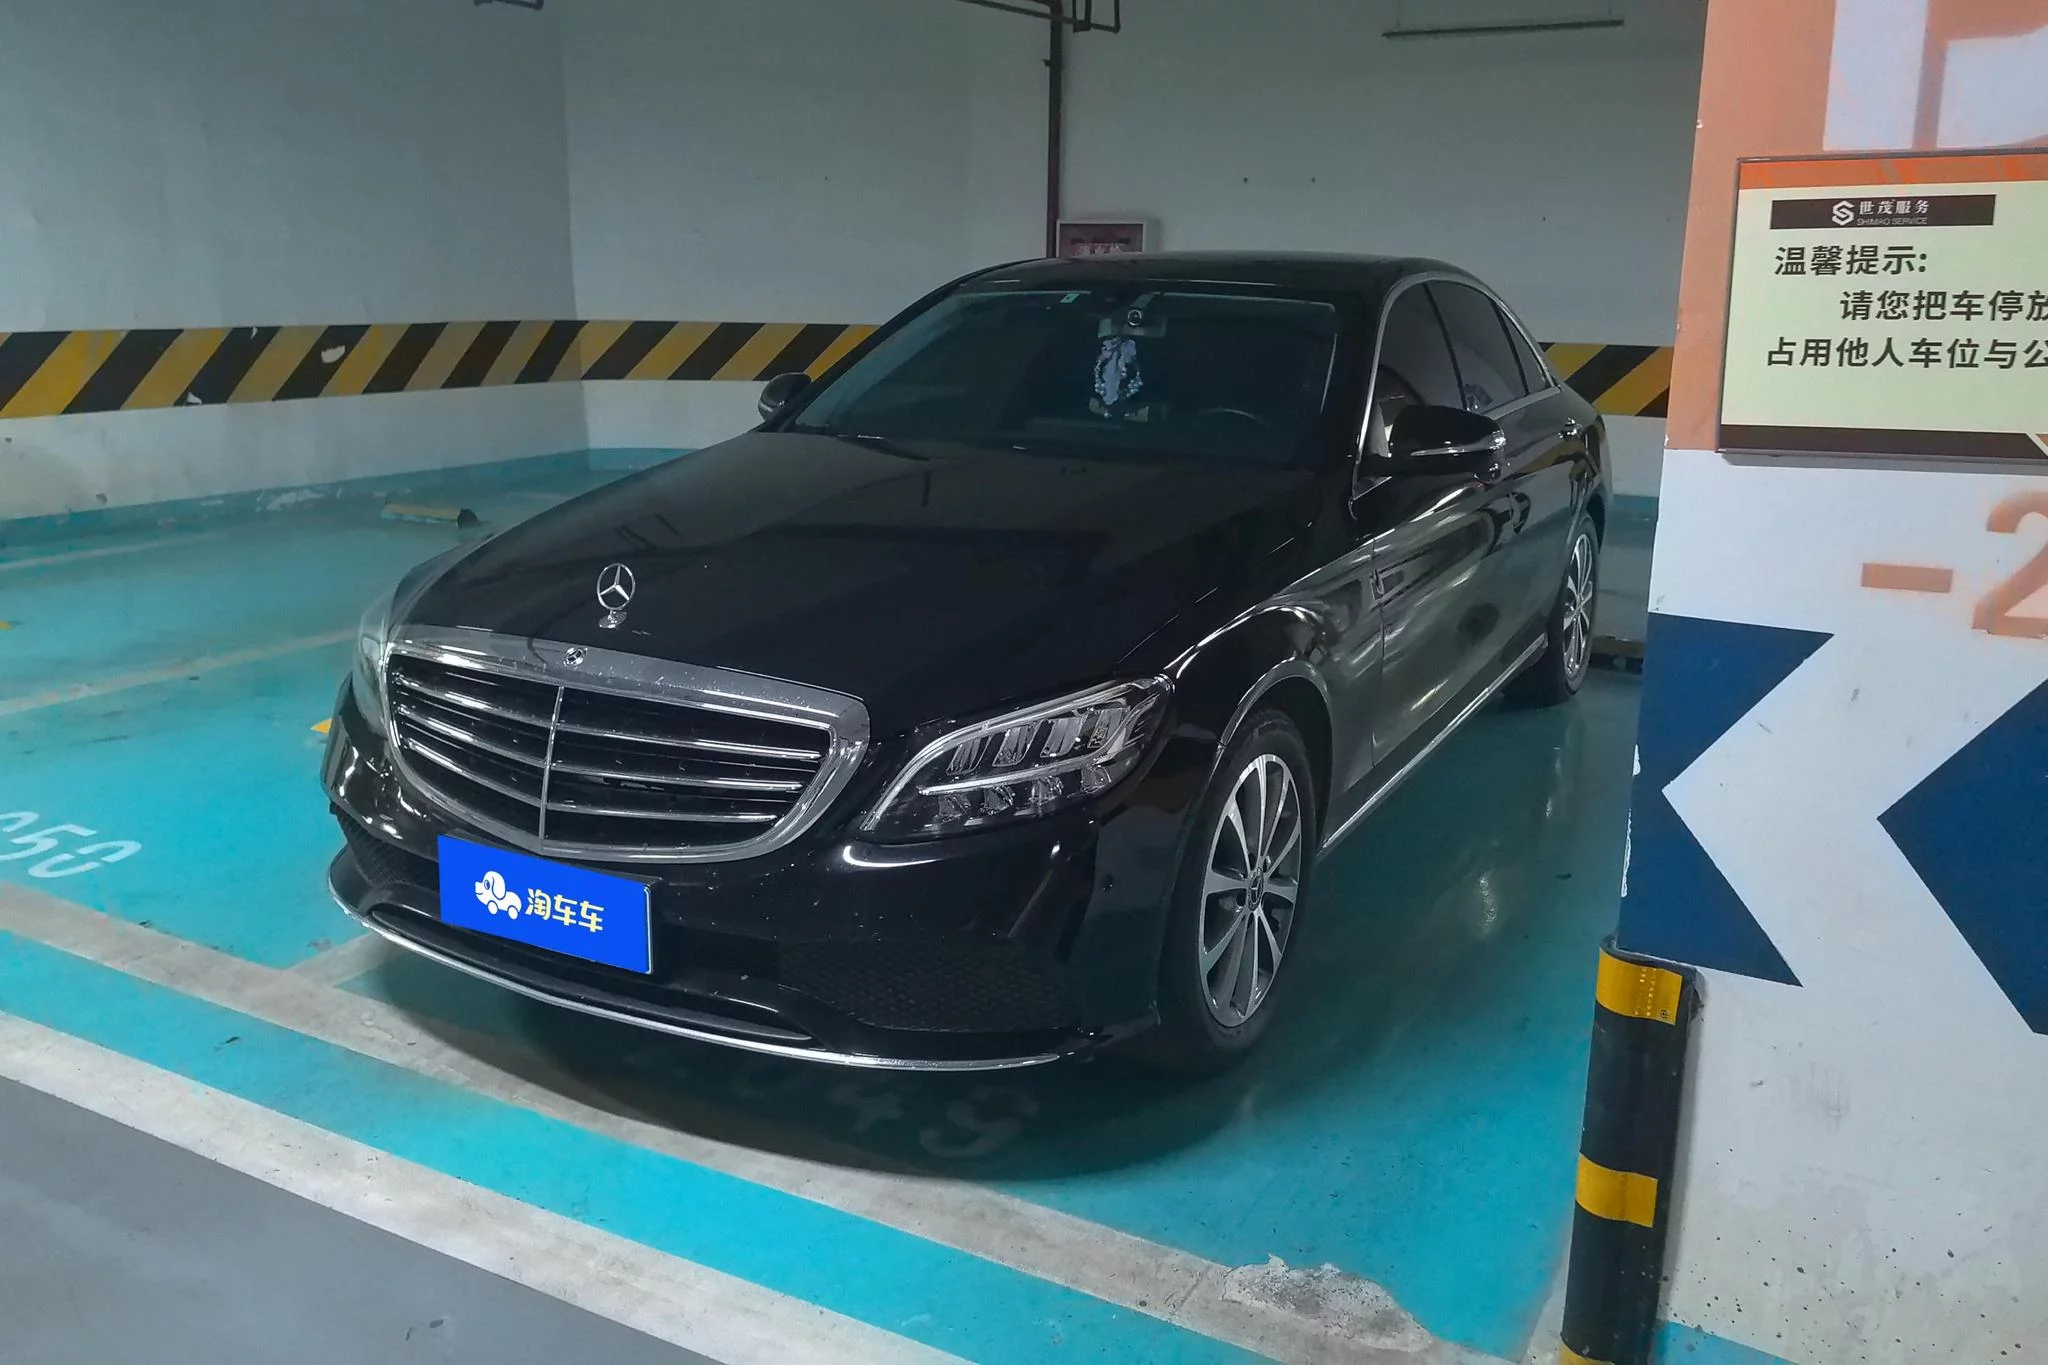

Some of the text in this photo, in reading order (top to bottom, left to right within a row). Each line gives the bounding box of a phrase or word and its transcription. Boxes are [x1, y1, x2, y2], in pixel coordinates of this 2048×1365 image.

[1859, 200, 1929, 215] 世茂服务
[1774, 244, 1927, 276] 温馨提示:
